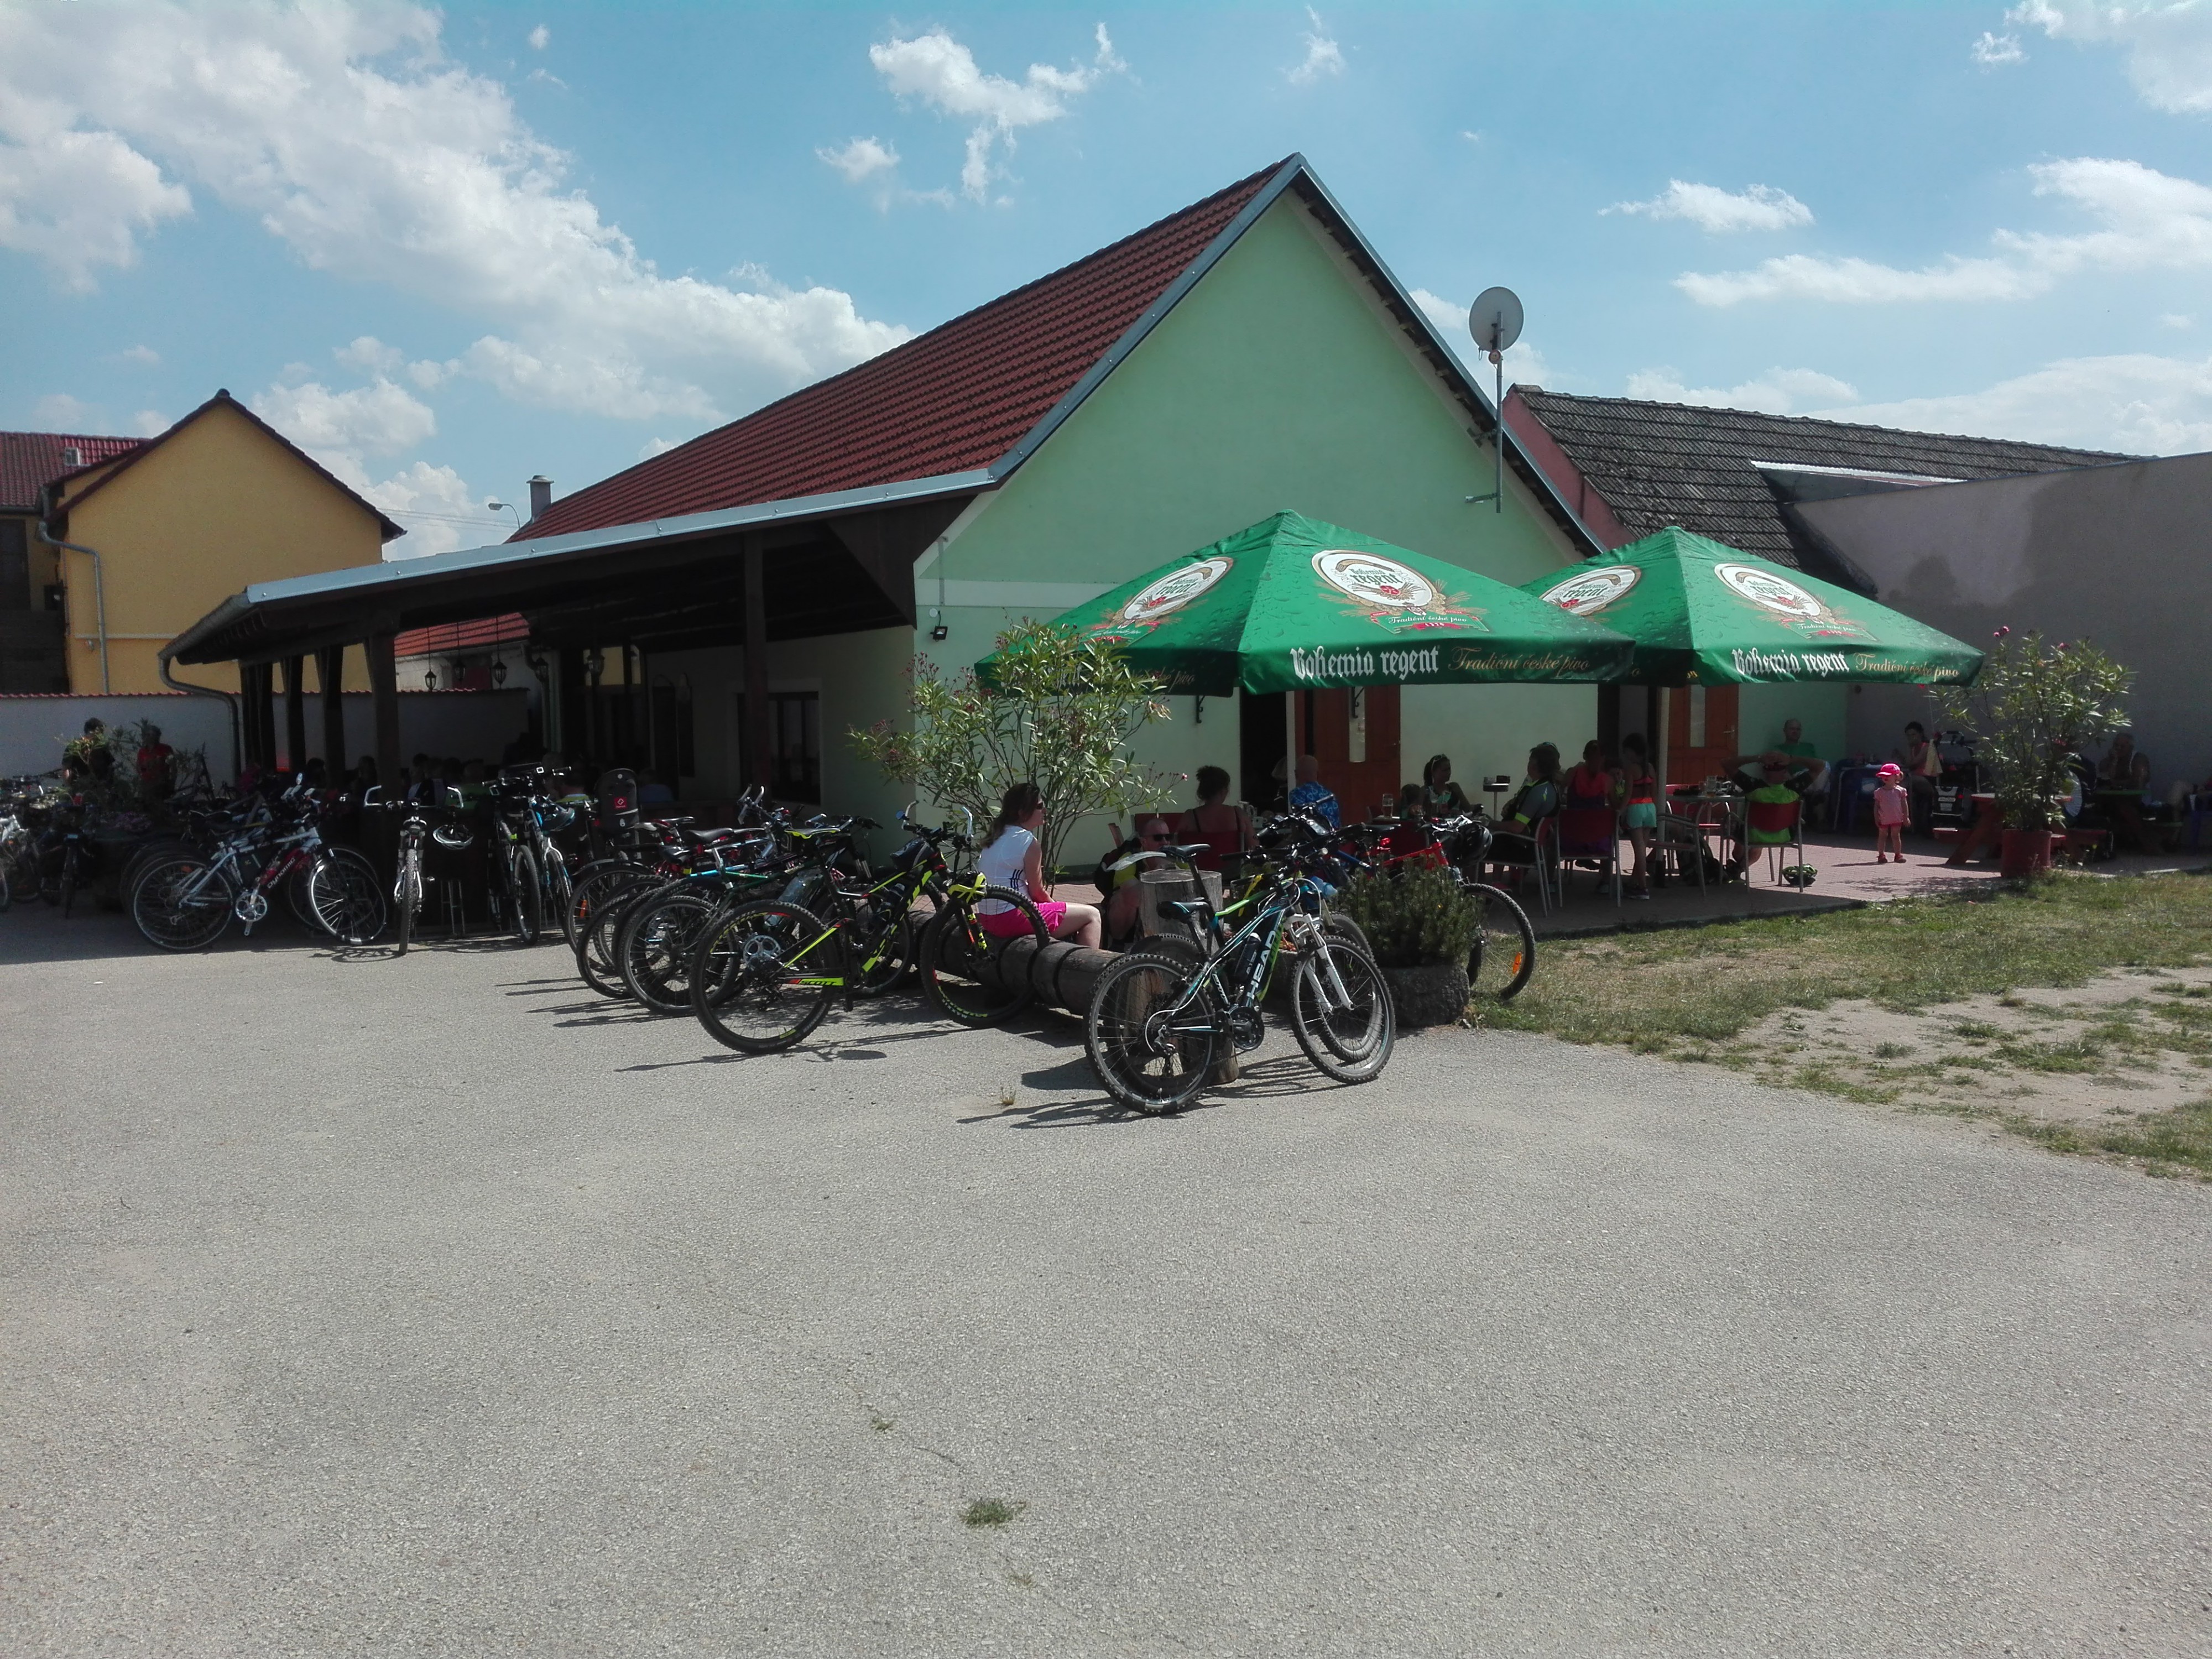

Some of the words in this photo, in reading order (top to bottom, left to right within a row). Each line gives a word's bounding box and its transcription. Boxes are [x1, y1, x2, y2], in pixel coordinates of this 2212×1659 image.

[1350, 573, 1404, 586] regent
[1290, 645, 1375, 680] Bohemia
[1380, 645, 1439, 680] regent
[1448, 646, 1522, 671] Tradiční
[1522, 651, 1563, 671] české
[1555, 657, 1590, 677] pivo
[1731, 647, 1801, 676] Bohemia
[1801, 650, 1850, 678] regent
[1853, 652, 1908, 672] Tradiční
[1933, 665, 1960, 682] pivo
[1246, 930, 1276, 1000] HEAD
